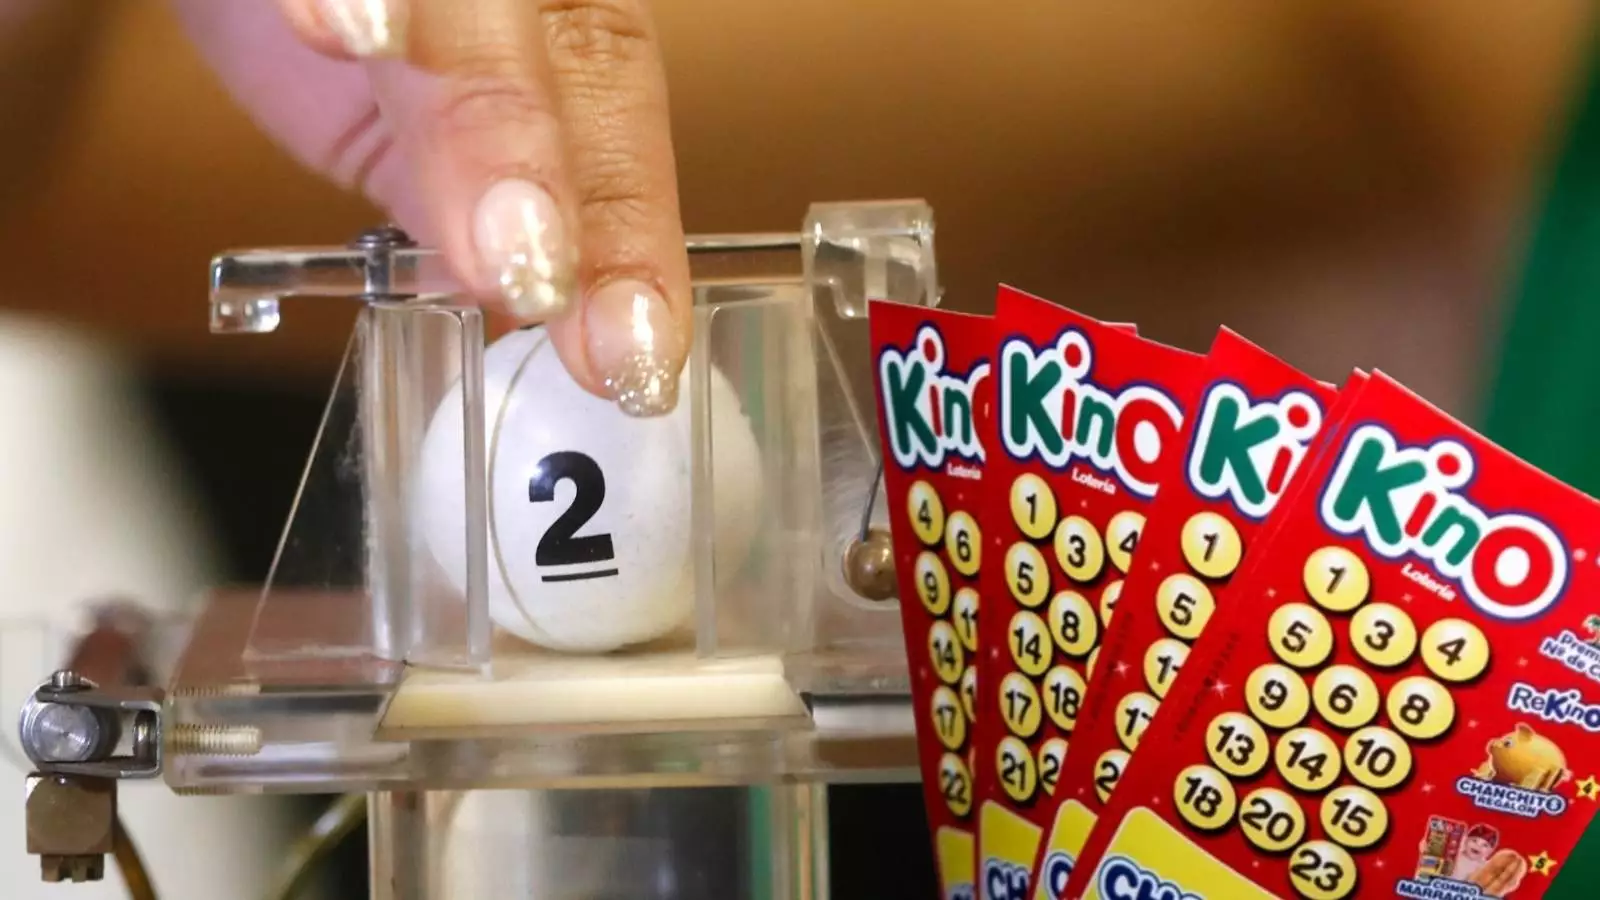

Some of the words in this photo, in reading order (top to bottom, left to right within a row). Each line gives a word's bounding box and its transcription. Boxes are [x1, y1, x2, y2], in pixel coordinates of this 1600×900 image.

[1200, 396, 1309, 505] Ki
[529, 451, 615, 566] 2
[918, 499, 932, 530] 4
[1026, 494, 1037, 525] 1
[956, 530, 971, 562] 6
[1068, 526, 1086, 568] 3
[1203, 533, 1219, 562] 1
[924, 571, 938, 604] 9
[1017, 562, 1034, 595] 5
[1327, 566, 1346, 593] 1
[1170, 593, 1196, 626] 5
[1061, 611, 1080, 643] 8
[1281, 621, 1312, 653] 5
[1365, 620, 1395, 652] 3
[933, 639, 956, 669] 14
[1014, 626, 1042, 665] 14
[1437, 637, 1467, 666] 4
[1561, 634, 1600, 661] Prem
[1006, 689, 1031, 725] 17
[1050, 682, 1080, 720] 18
[1259, 680, 1288, 711] 9
[1328, 684, 1358, 714] 6
[1400, 694, 1431, 726] 8
[937, 705, 956, 736] 17
[1216, 725, 1255, 766] 13
[1286, 741, 1328, 781] 14
[1355, 737, 1397, 777] 10
[1002, 753, 1027, 791] 21
[1042, 754, 1060, 785] 2
[1096, 761, 1119, 793] 2
[942, 769, 966, 804] 22
[1184, 777, 1223, 818] 18
[1242, 797, 1294, 842] 20
[1331, 799, 1374, 838] 15
[1292, 849, 1344, 893] 23
